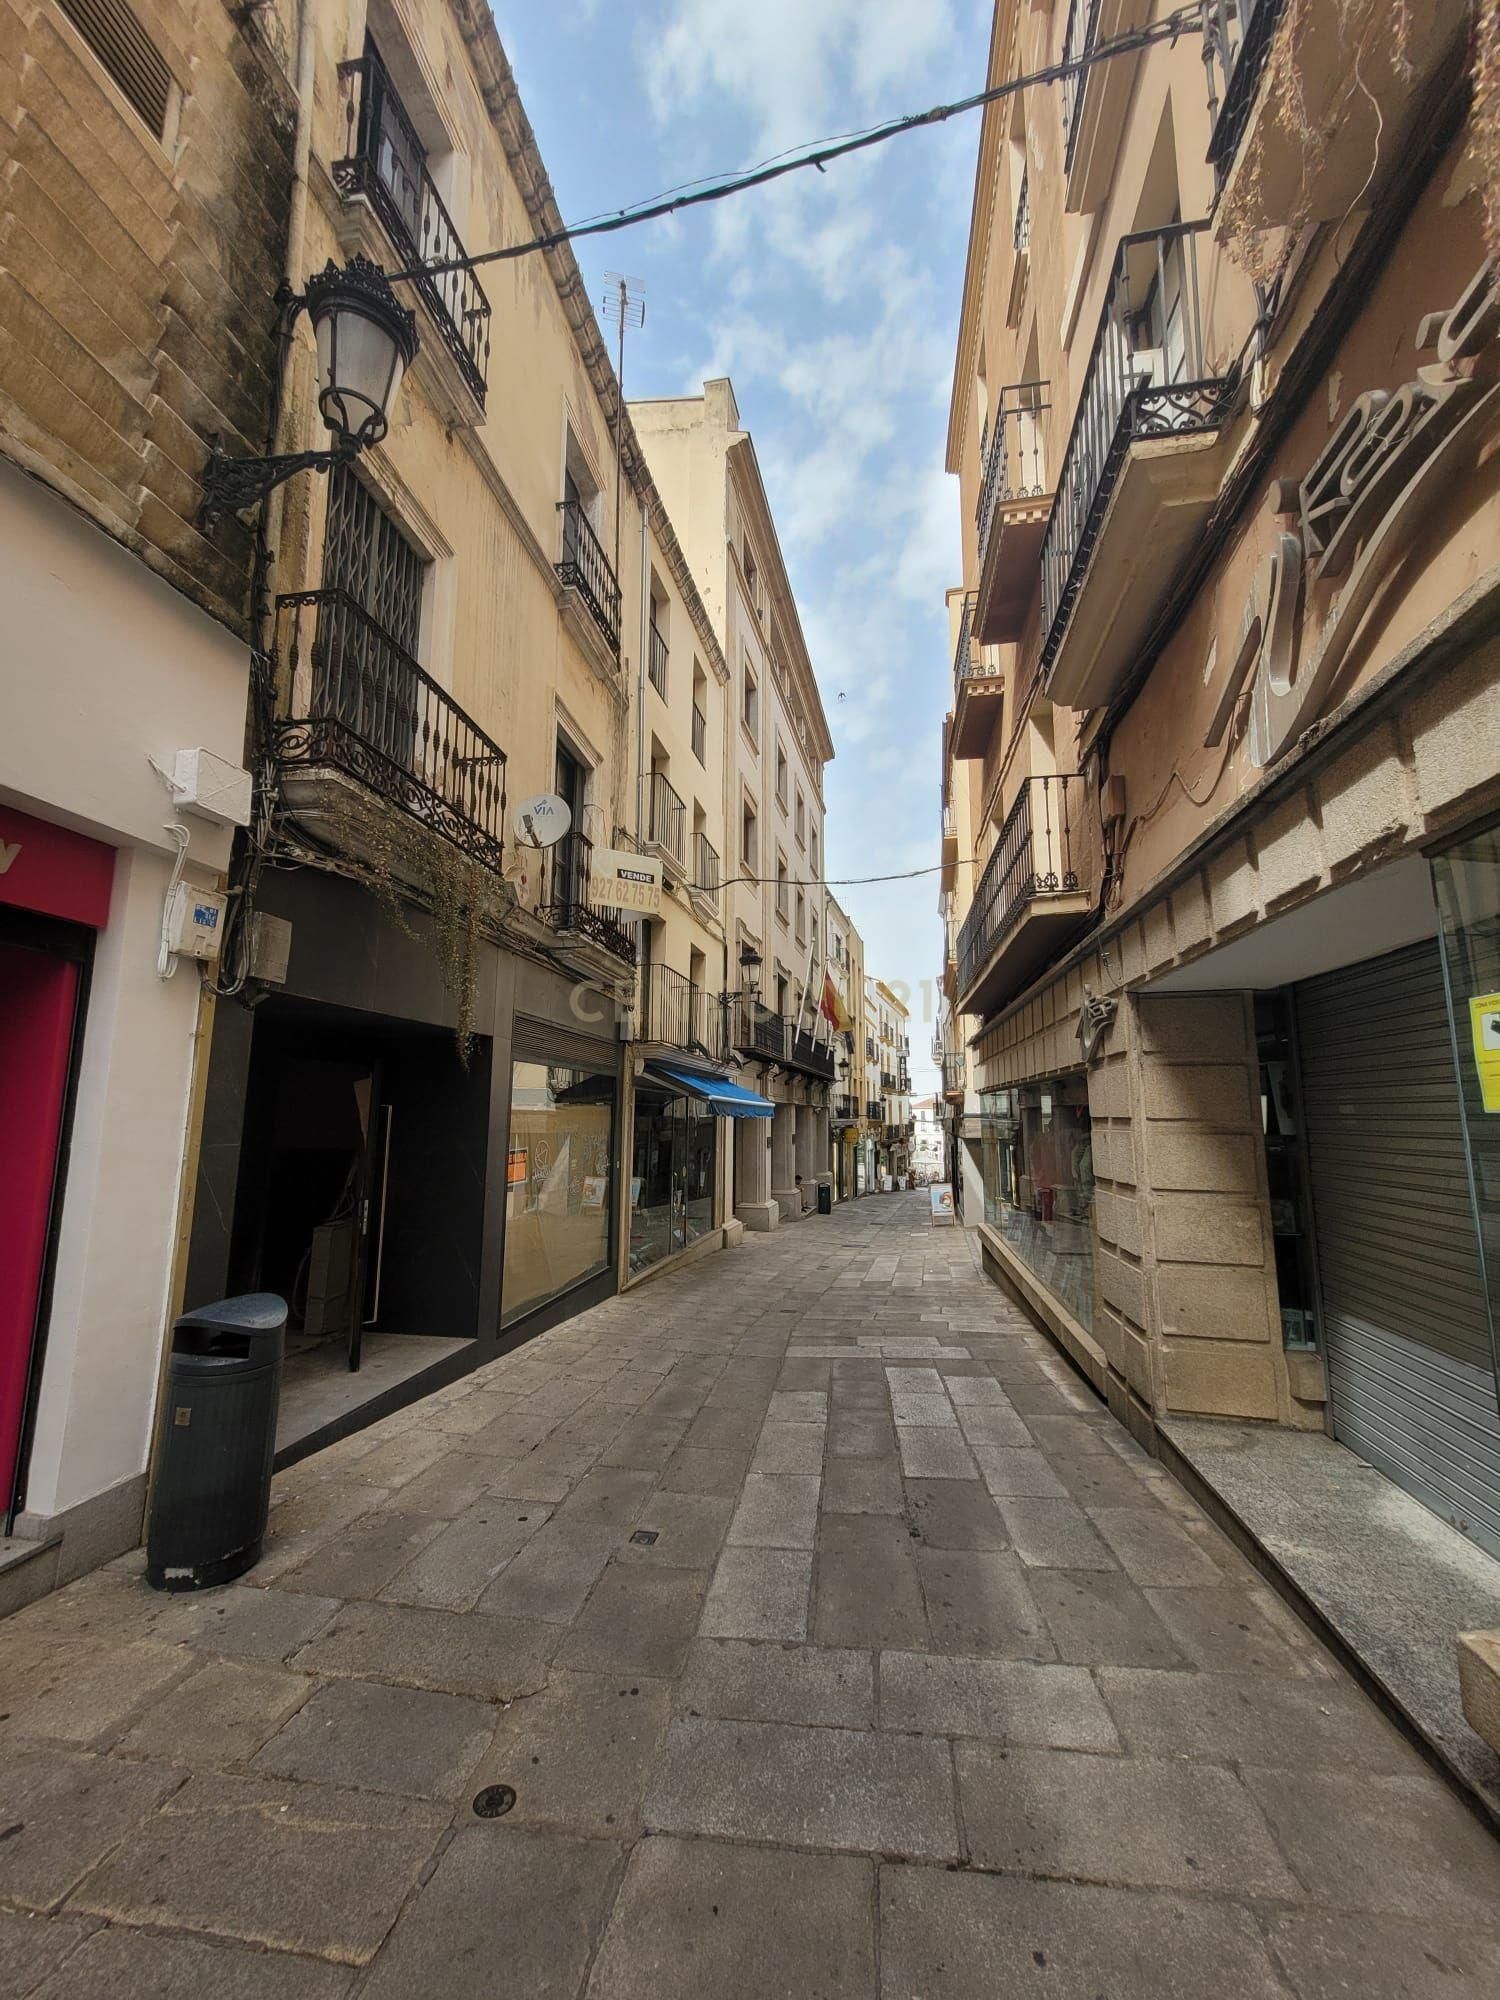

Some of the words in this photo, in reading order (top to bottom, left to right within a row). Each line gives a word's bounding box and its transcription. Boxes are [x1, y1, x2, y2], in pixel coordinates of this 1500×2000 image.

[620, 870, 652, 883] VENDE
[591, 877, 614, 899] 927
[616, 880, 629, 902] 62
[632, 883, 645, 905] 75
[648, 885, 660, 908] 75
